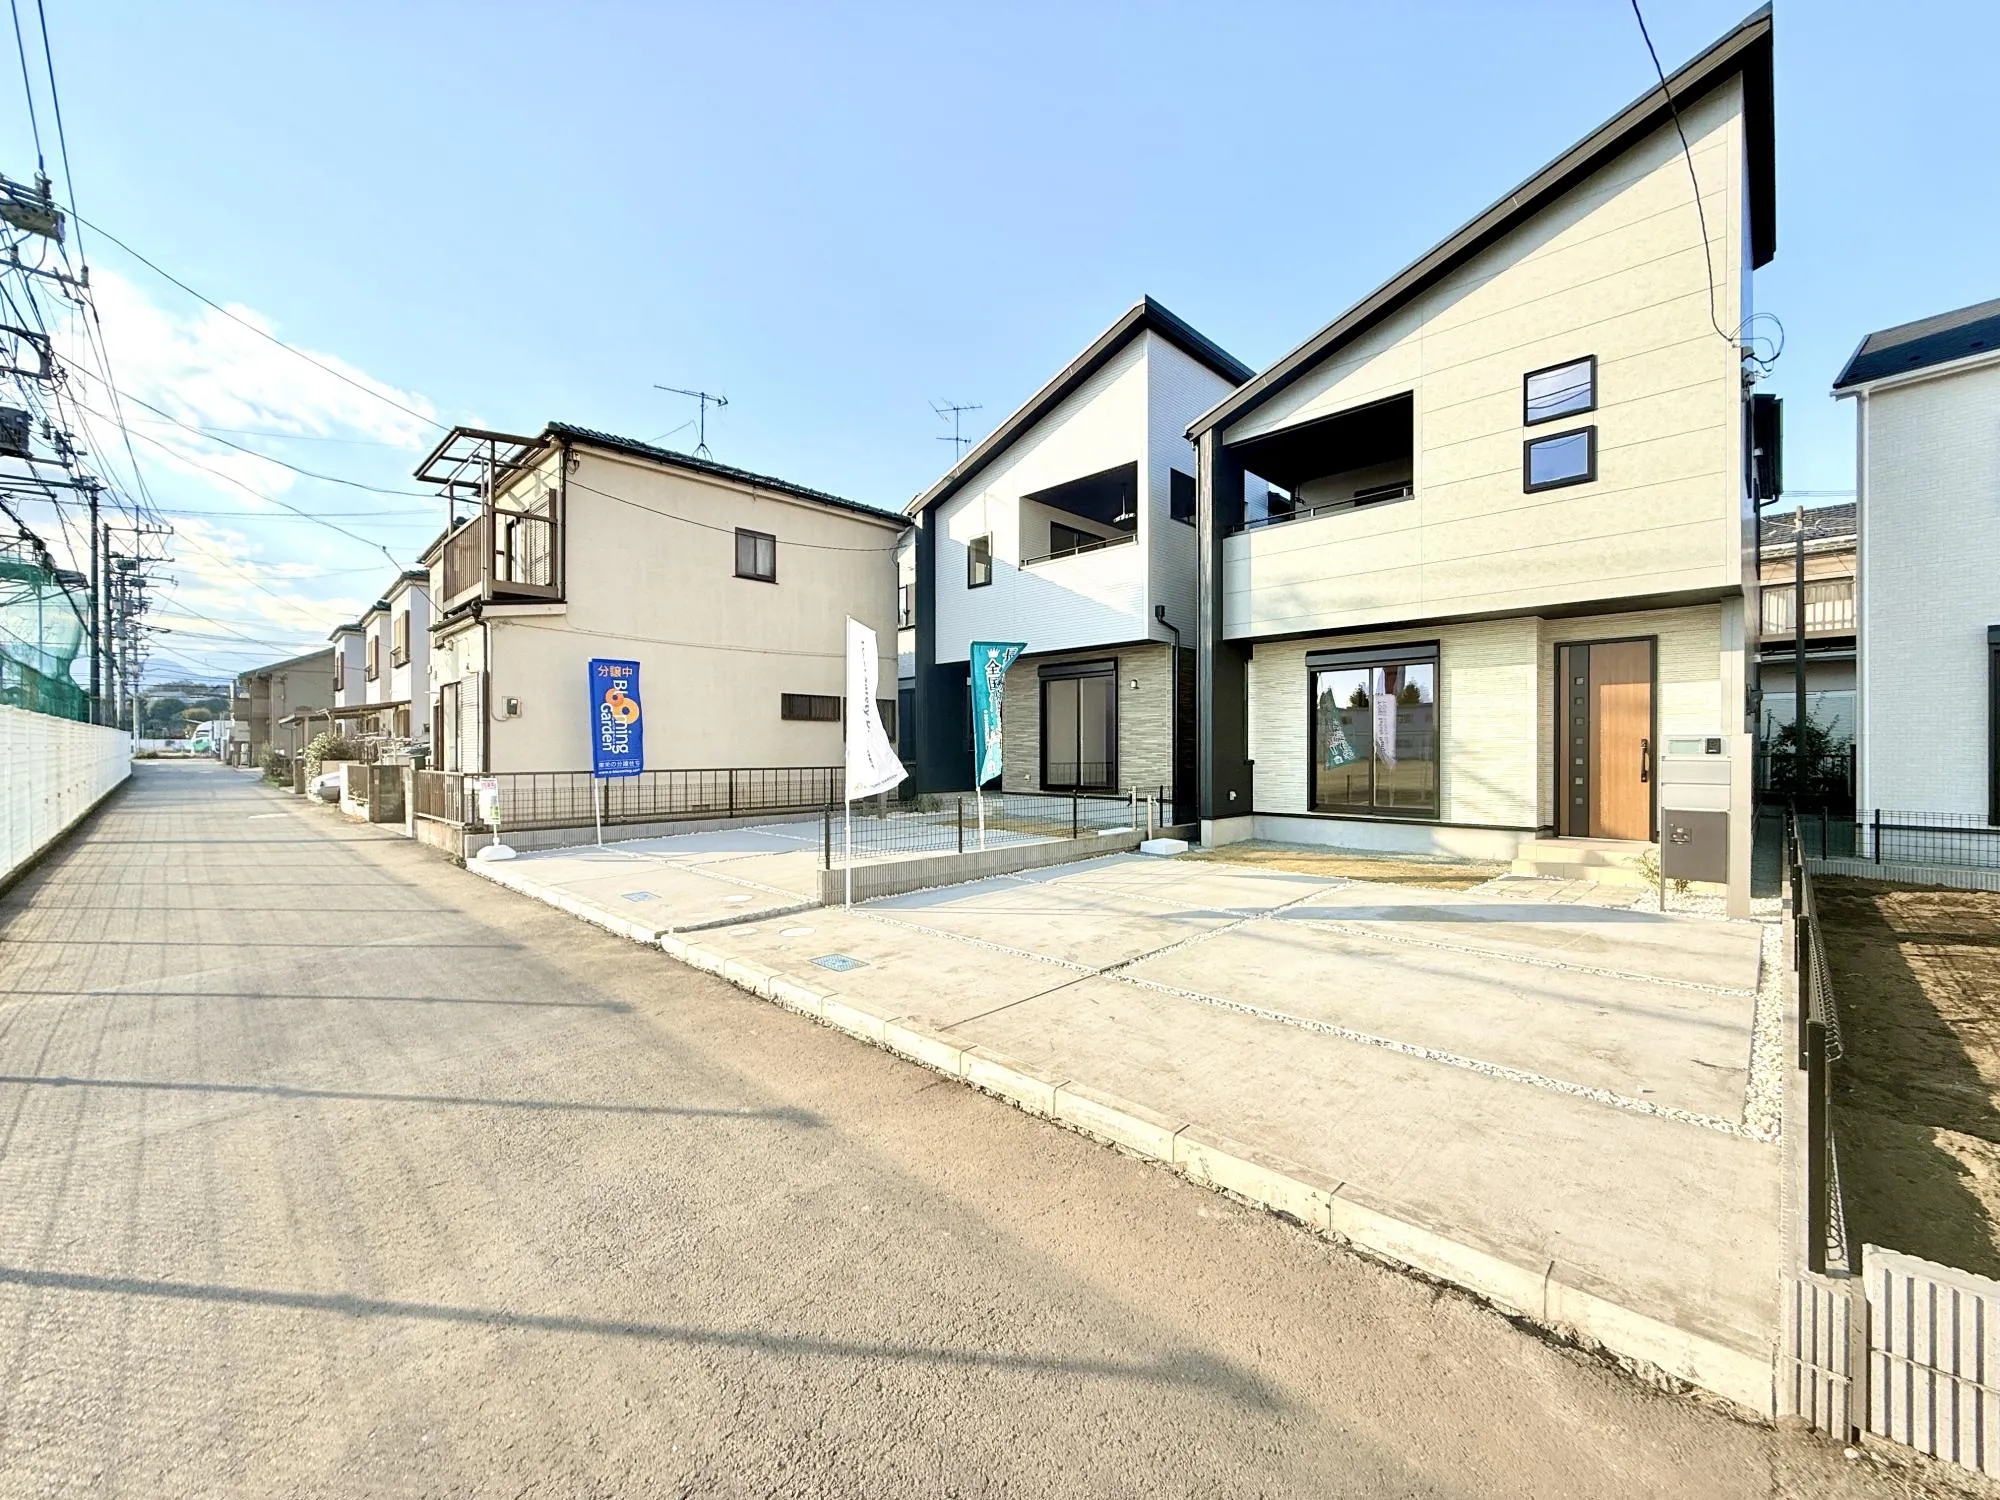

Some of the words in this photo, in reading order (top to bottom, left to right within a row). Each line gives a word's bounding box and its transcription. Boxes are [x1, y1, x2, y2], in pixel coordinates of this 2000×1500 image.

[597, 664, 633, 678] 分譲中
[600, 702, 616, 751] Garden
[605, 679, 639, 754] Blooming
